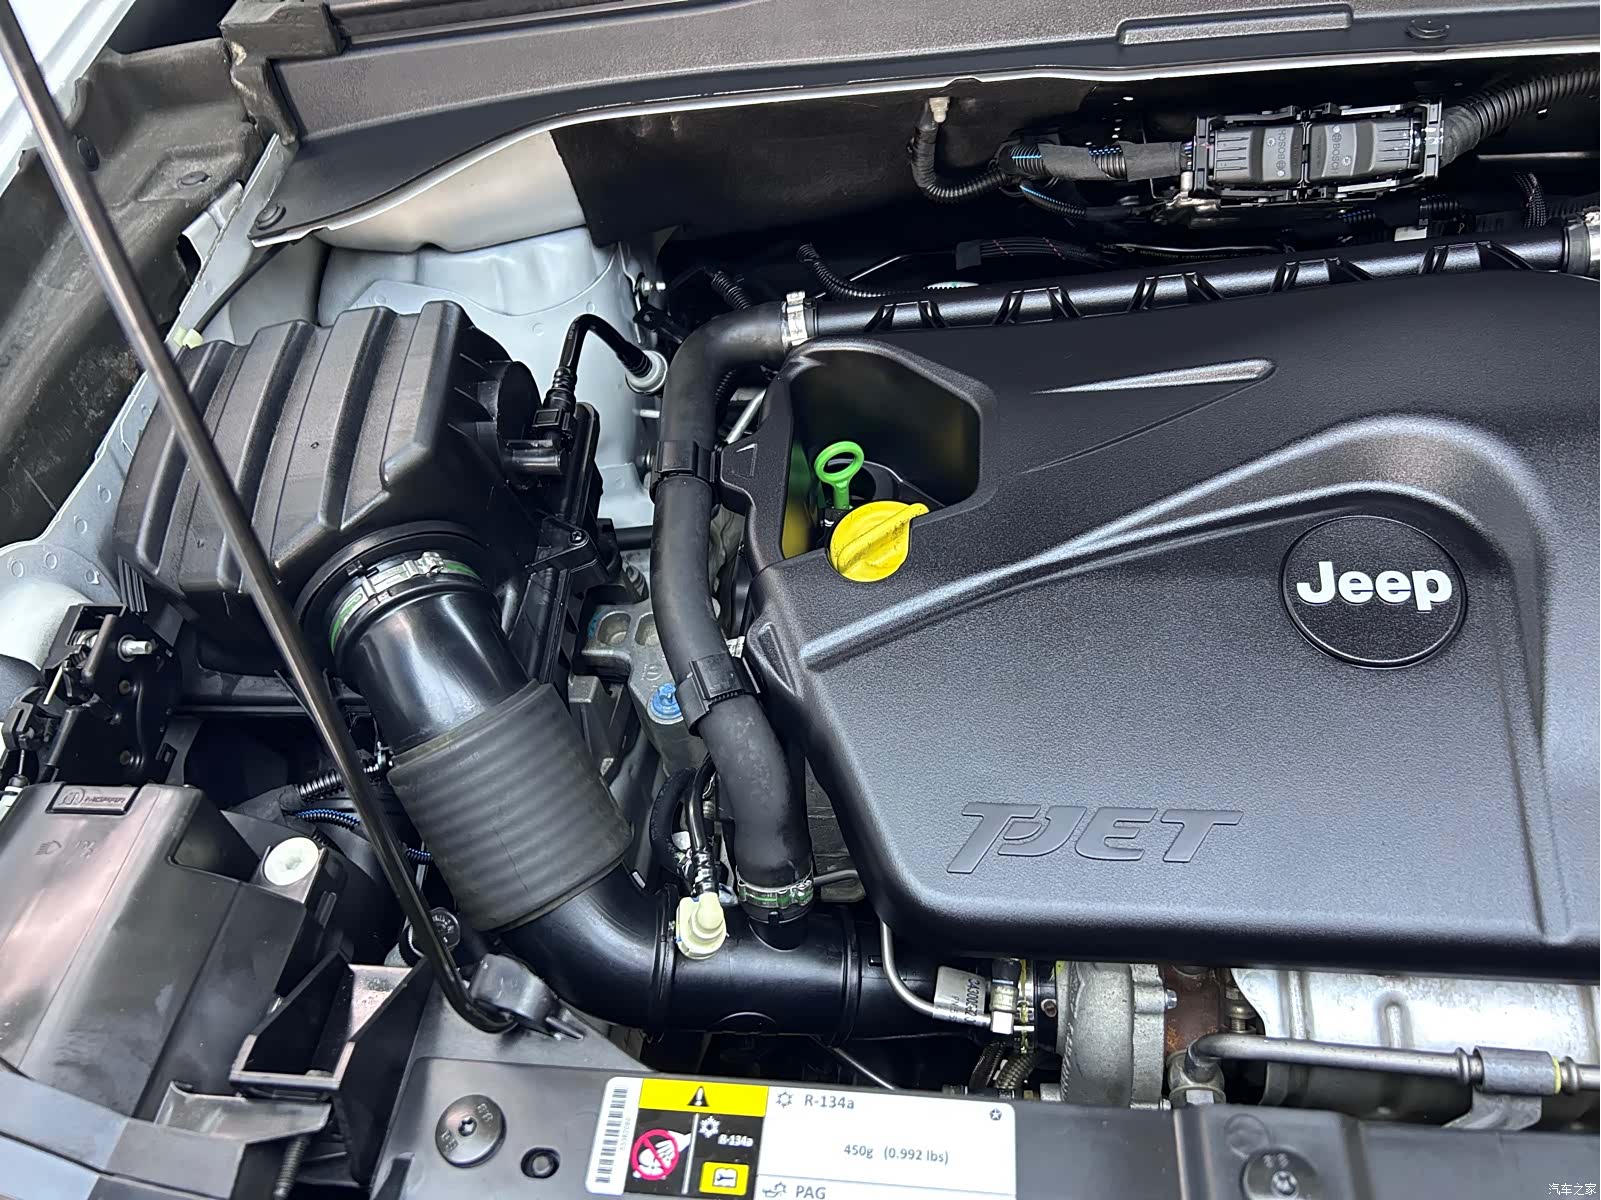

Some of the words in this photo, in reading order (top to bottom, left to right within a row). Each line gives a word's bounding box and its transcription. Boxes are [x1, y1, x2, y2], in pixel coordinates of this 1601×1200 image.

[1278, 128, 1287, 160] BOSCH
[1331, 143, 1341, 175] BOSCH
[1297, 561, 1453, 611] Jeep
[804, 1094, 855, 1109] R-134a
[717, 1133, 754, 1148] R-134a
[843, 1144, 874, 1160] 450g
[884, 1145, 923, 1161] (0.992
[926, 1149, 949, 1165] lbs)
[796, 1185, 826, 1199] PAG
